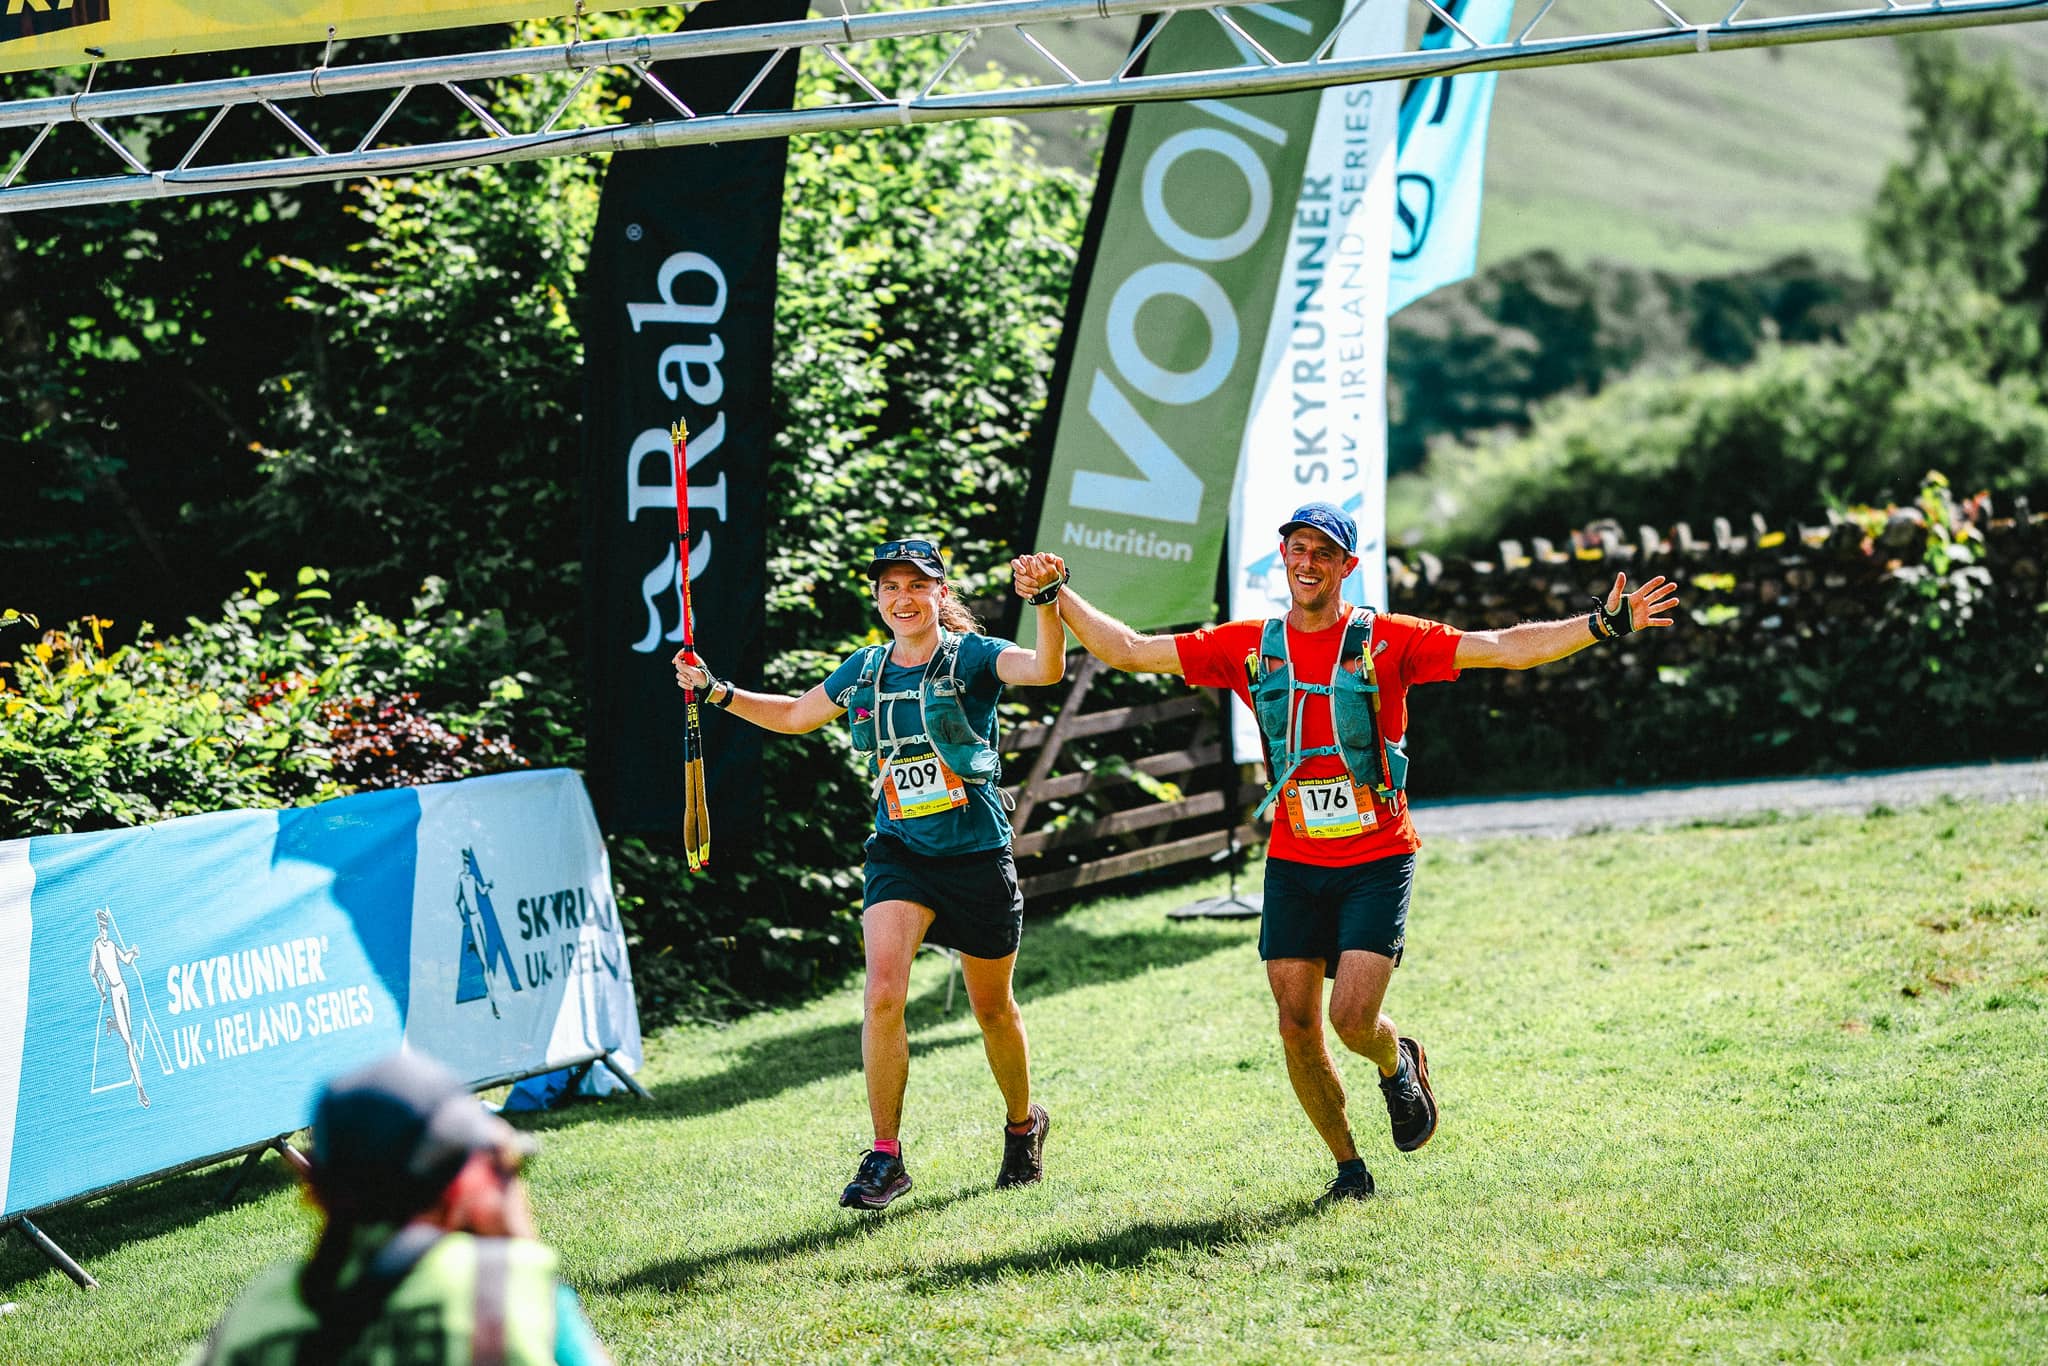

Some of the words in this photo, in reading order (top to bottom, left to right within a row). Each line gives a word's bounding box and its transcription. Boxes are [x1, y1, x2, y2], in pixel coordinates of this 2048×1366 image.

[1338, 87, 1374, 217] SERIES
[1293, 172, 1333, 485] SKYRUNNER
[1337, 232, 1366, 400] IRELAND
[1062, 521, 1193, 563] Nutrition
[895, 763, 937, 790] 209
[1307, 787, 1348, 811] 176
[166, 936, 328, 1015] SKYRUNNER
[525, 950, 553, 989] UK
[304, 984, 375, 1037] SERIES
